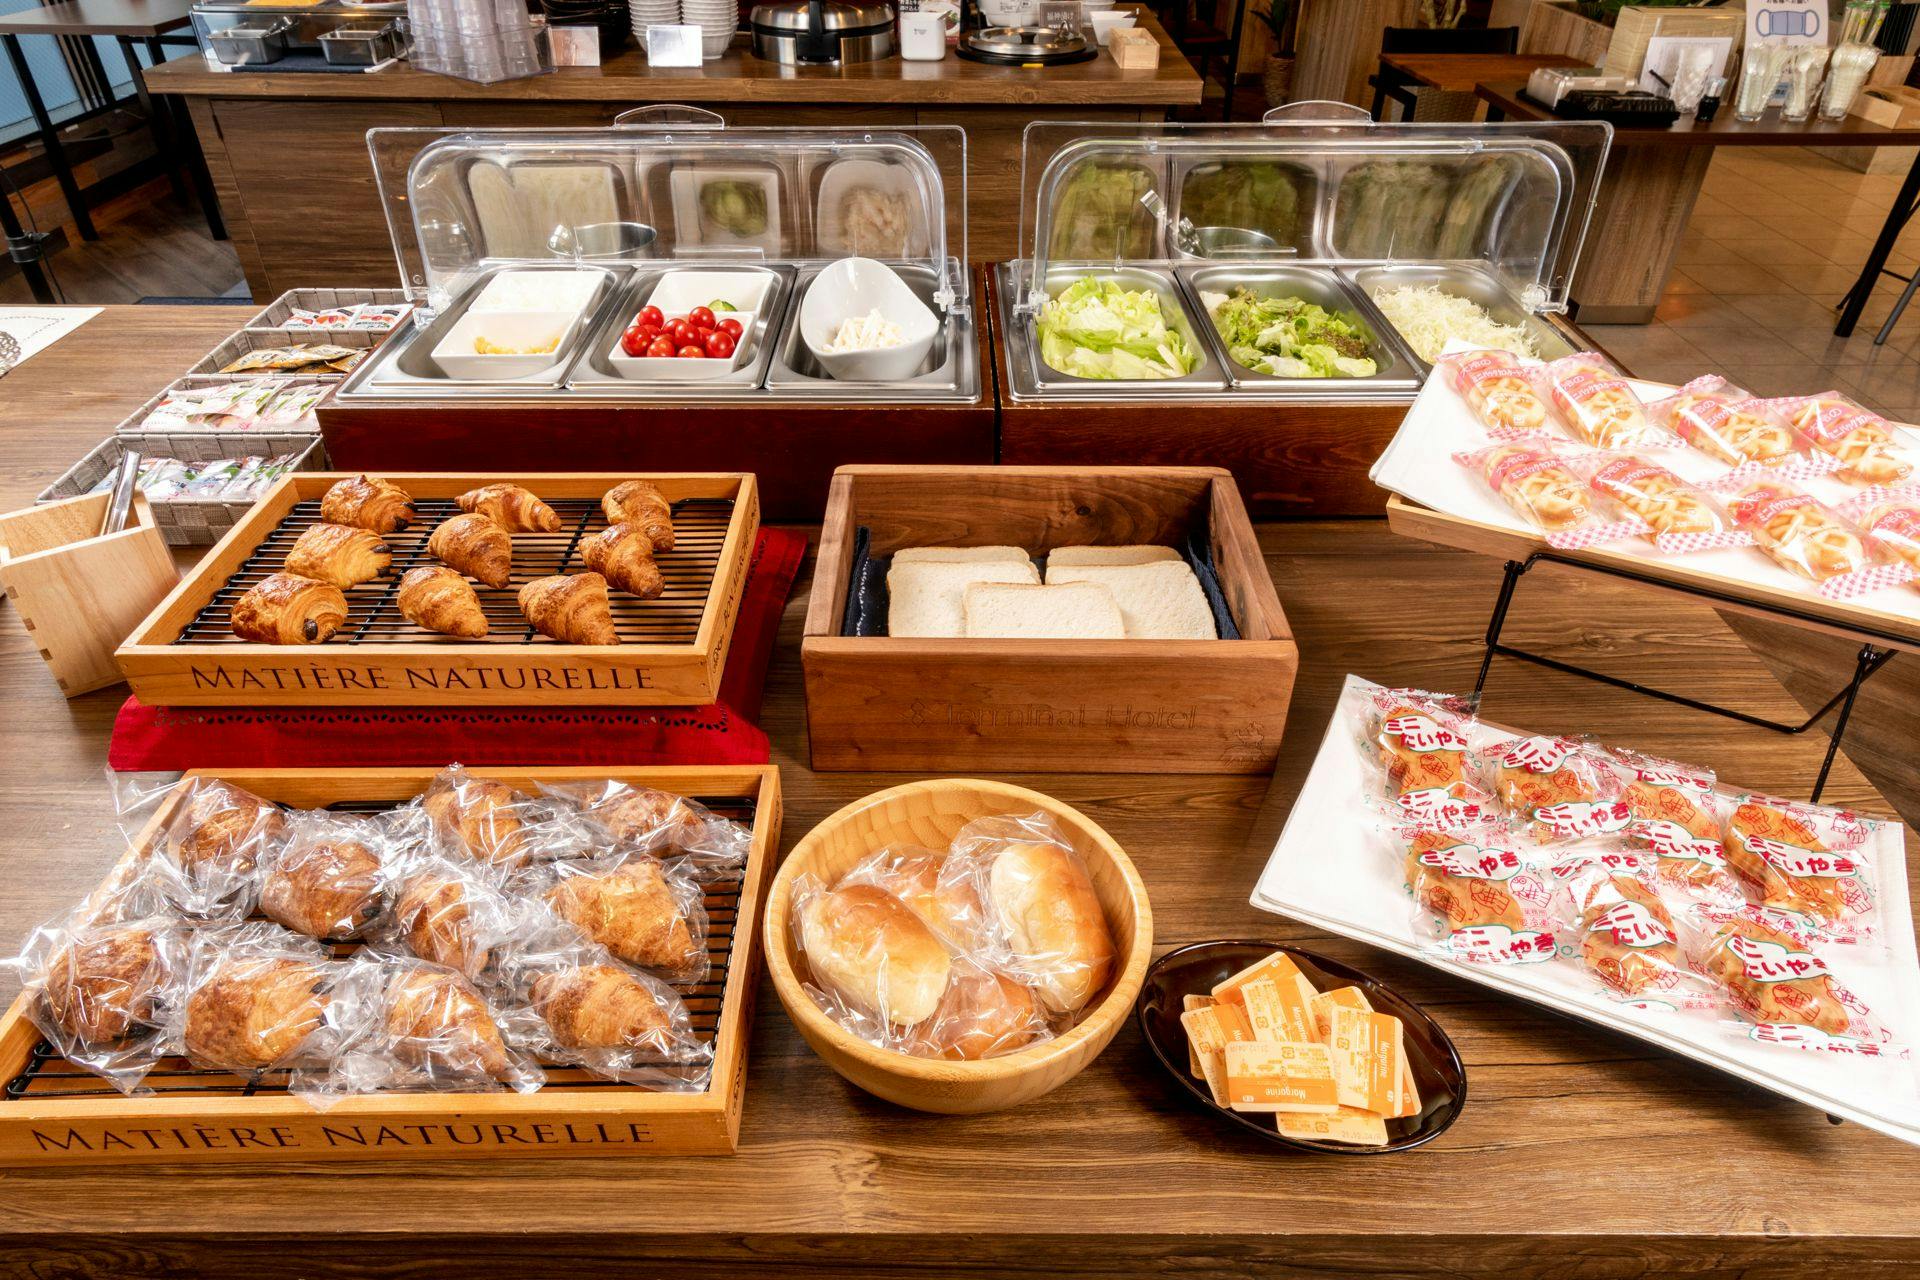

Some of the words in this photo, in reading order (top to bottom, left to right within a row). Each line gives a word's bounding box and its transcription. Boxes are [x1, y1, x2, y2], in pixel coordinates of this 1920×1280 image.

[191, 662, 389, 690] MATIÈRE
[406, 667, 655, 690] NATURELLE
[934, 702, 1086, 728] Terminal
[1105, 703, 1198, 729] Hotel
[1378, 1040, 1391, 1078] Margarine
[1265, 1086, 1306, 1099] Margarine
[31, 1122, 300, 1151] MATIÈRE
[321, 1122, 655, 1147] NATURELLE
